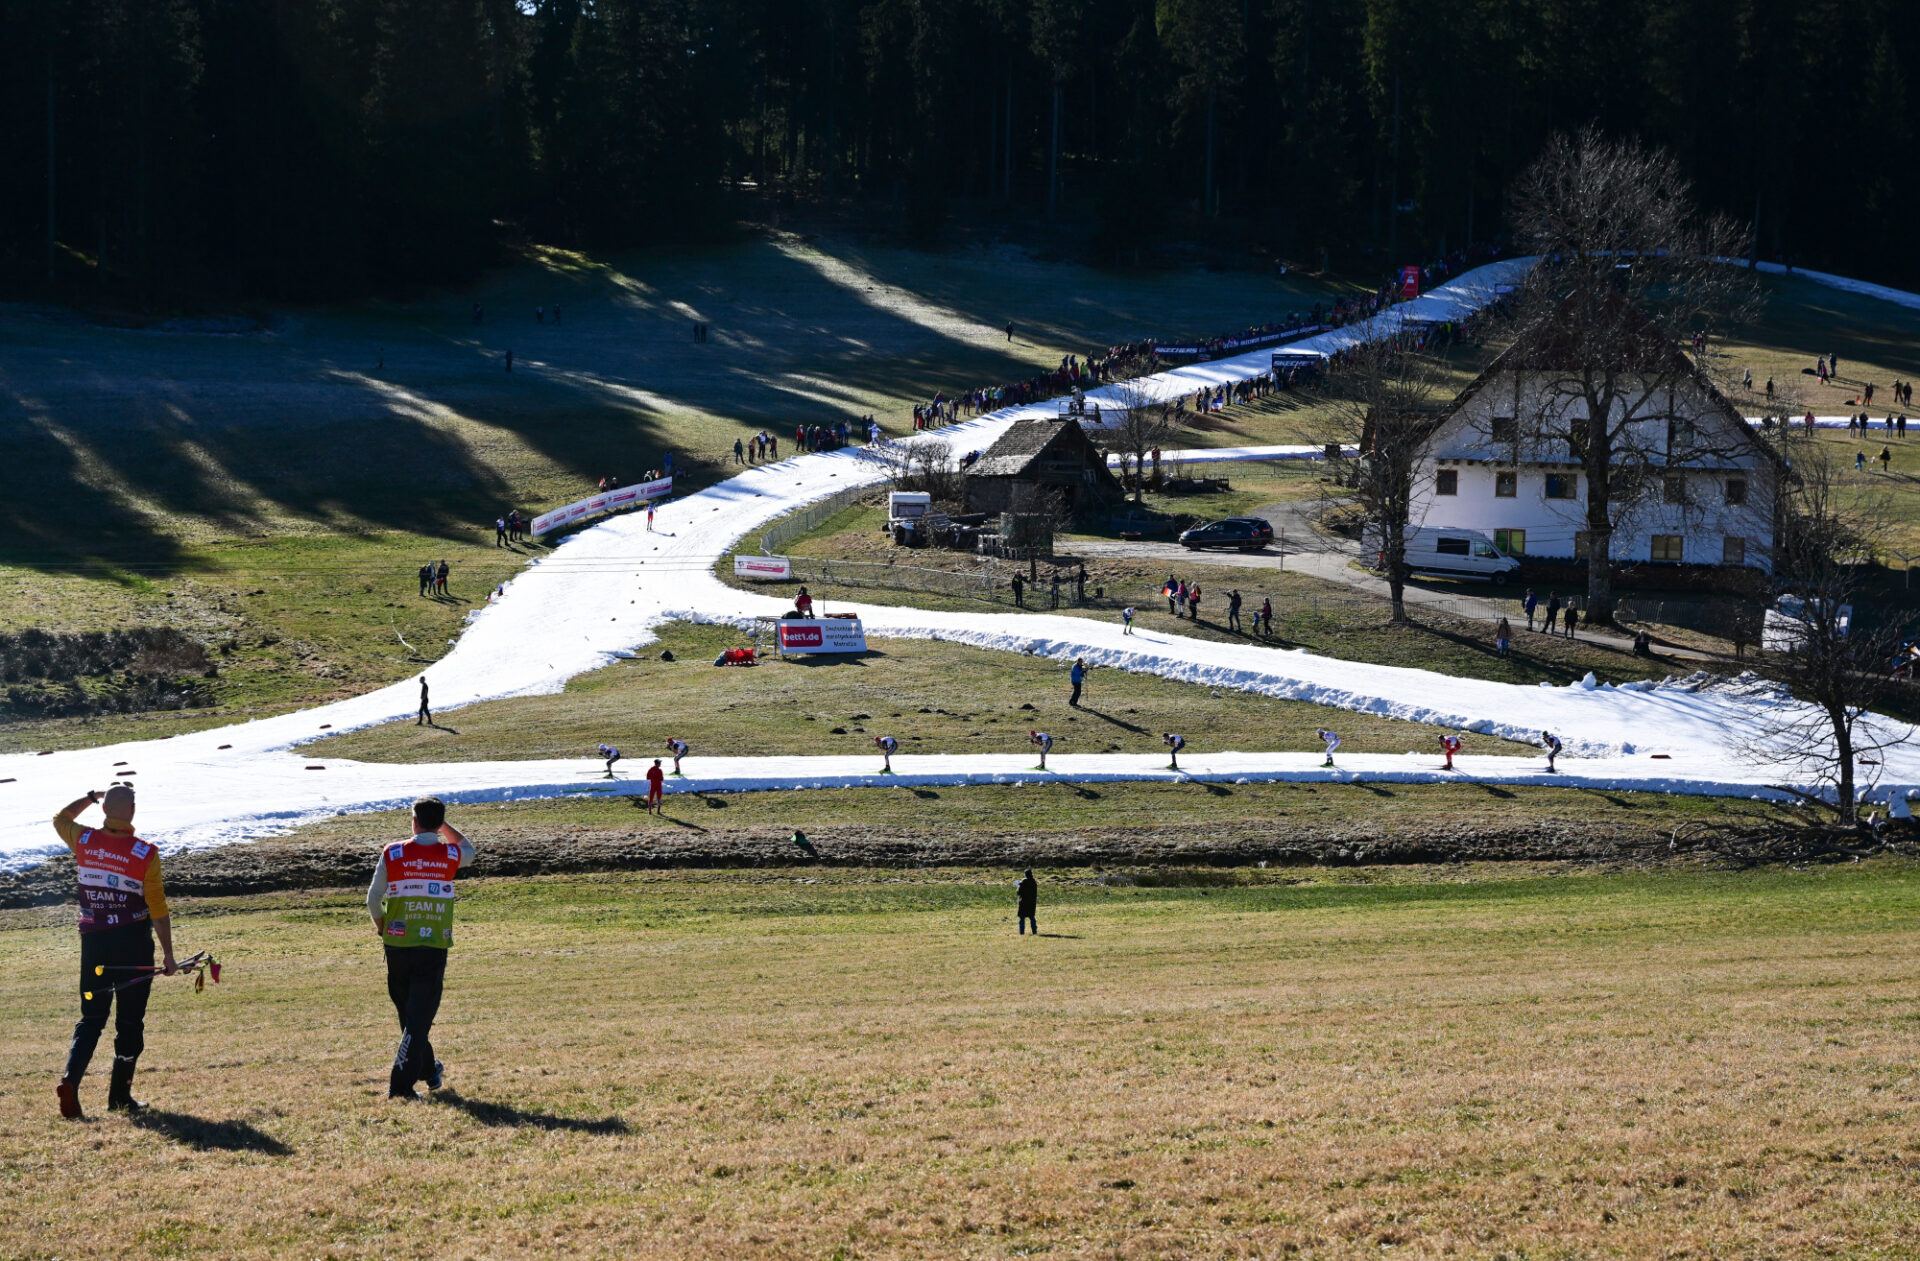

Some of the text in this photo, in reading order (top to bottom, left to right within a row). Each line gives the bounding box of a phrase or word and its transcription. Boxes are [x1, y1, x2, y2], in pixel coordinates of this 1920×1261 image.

[783, 633, 820, 641] bett1.de
[84, 848, 130, 864] VIESSMANN
[402, 858, 448, 870] VIESSMANN
[85, 889, 115, 901] TEAM
[404, 901, 446, 913] TEAM M
[107, 914, 119, 924] 31
[419, 927, 432, 937] 62
